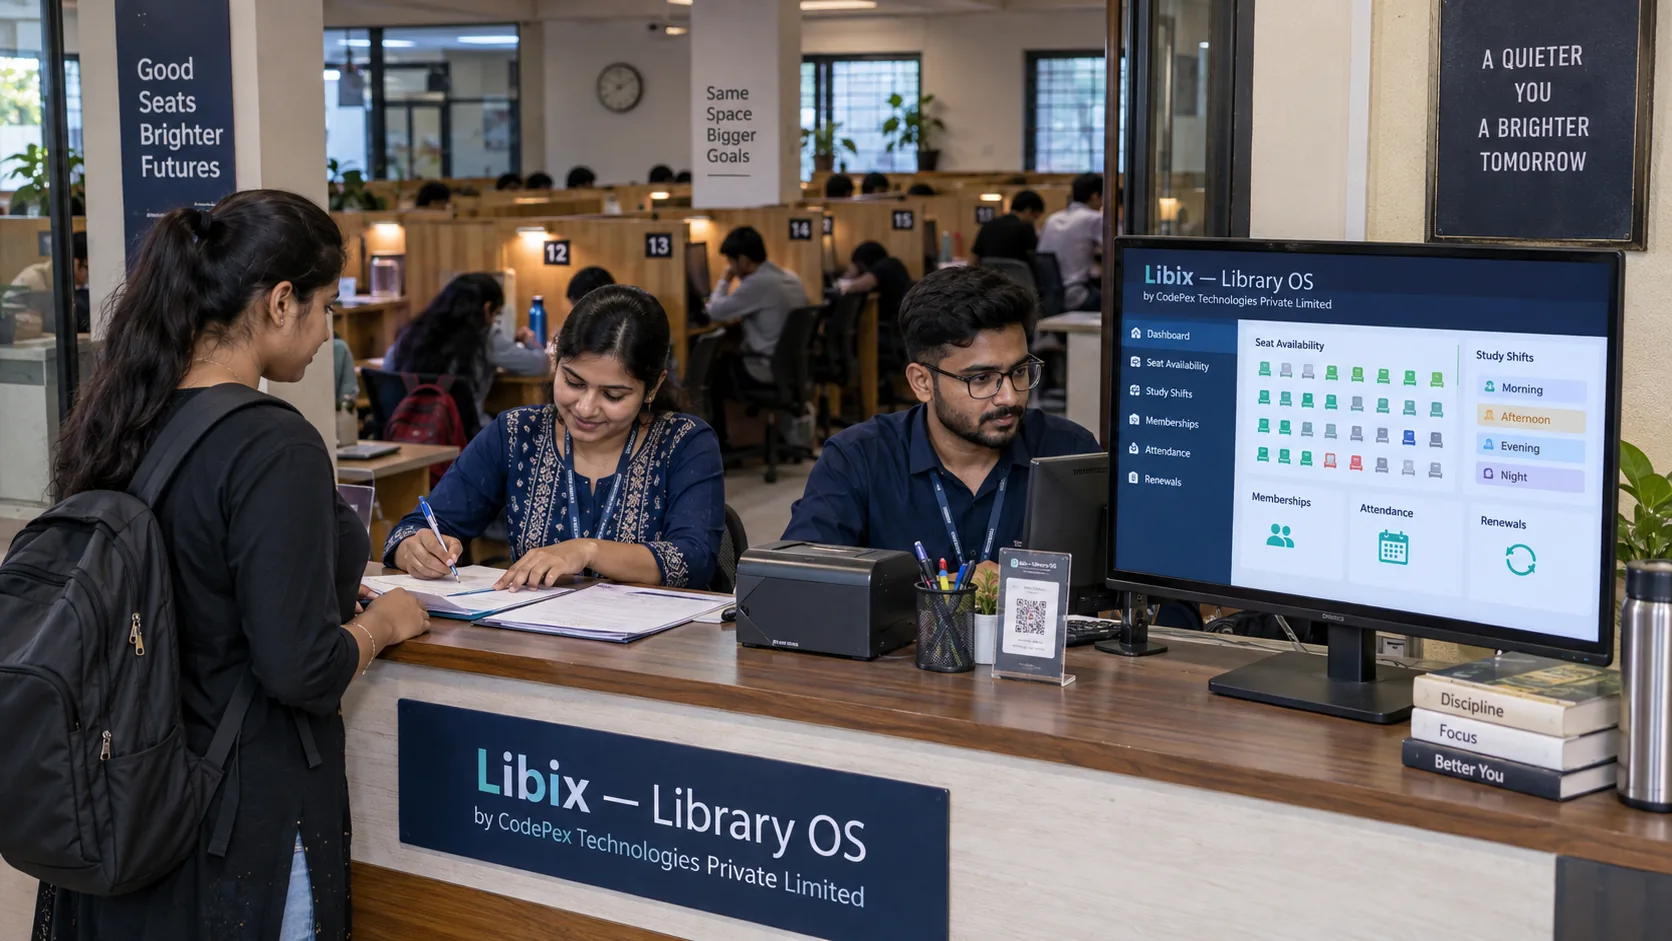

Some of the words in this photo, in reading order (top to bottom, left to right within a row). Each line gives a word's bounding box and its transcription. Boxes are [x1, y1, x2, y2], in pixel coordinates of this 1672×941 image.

[1482, 50, 1494, 69] A
[1502, 45, 1582, 69] QUIETER
[138, 57, 193, 81] Good
[707, 86, 749, 100] Same
[1515, 82, 1551, 103] YOU
[139, 91, 196, 113] Seats
[707, 107, 752, 123] Space
[1478, 118, 1489, 138] A
[1498, 116, 1589, 139] BRIGHTER
[141, 123, 223, 149] Brighter
[707, 128, 757, 145] Bigger
[707, 148, 750, 163] Goals
[1480, 151, 1586, 172] TOMORROW
[142, 156, 220, 178] Futures
[895, 213, 912, 228] 15
[791, 222, 810, 237] 14
[649, 236, 669, 254] 13
[548, 244, 567, 262] 12
[1145, 265, 1194, 285] Libix
[1222, 270, 1283, 294] Library
[1288, 273, 1314, 291] OS
[1143, 291, 1154, 302] by
[1156, 292, 1195, 303] CodePex
[1198, 293, 1257, 307] Technologies
[1260, 297, 1293, 308] Private
[1296, 298, 1332, 309] Limited
[1147, 330, 1190, 341] Dashboard
[1255, 338, 1274, 348] Seat
[1276, 339, 1324, 352] Availability
[1476, 350, 1504, 363] Study
[1506, 351, 1534, 363] Shifts
[1147, 358, 1165, 368] Seat
[1165, 359, 1209, 372] Availability
[1146, 387, 1169, 399] Study
[1170, 388, 1193, 399] Shifts
[1502, 383, 1543, 397] Morning
[1145, 416, 1199, 429] Memberships
[1501, 412, 1551, 425] Afternoon
[1145, 445, 1191, 458] Attendance
[1501, 441, 1540, 455] Evening
[1144, 474, 1182, 487] Renewals
[1501, 471, 1528, 483] Night
[1252, 492, 1311, 507] Memberships
[1360, 504, 1414, 518] Attendance
[1481, 516, 1527, 530] Renewals
[1441, 692, 1504, 718] Discipline
[1439, 724, 1477, 744] Focus
[1435, 754, 1476, 776] Better
[1478, 764, 1504, 783] You
[477, 748, 591, 814] Libix
[653, 783, 795, 858] Library
[808, 814, 867, 863] OS
[474, 806, 494, 830] by
[498, 812, 572, 846] CodePex
[576, 828, 700, 872] Technologies
[707, 855, 777, 889] Private
[784, 873, 865, 908] Limited
